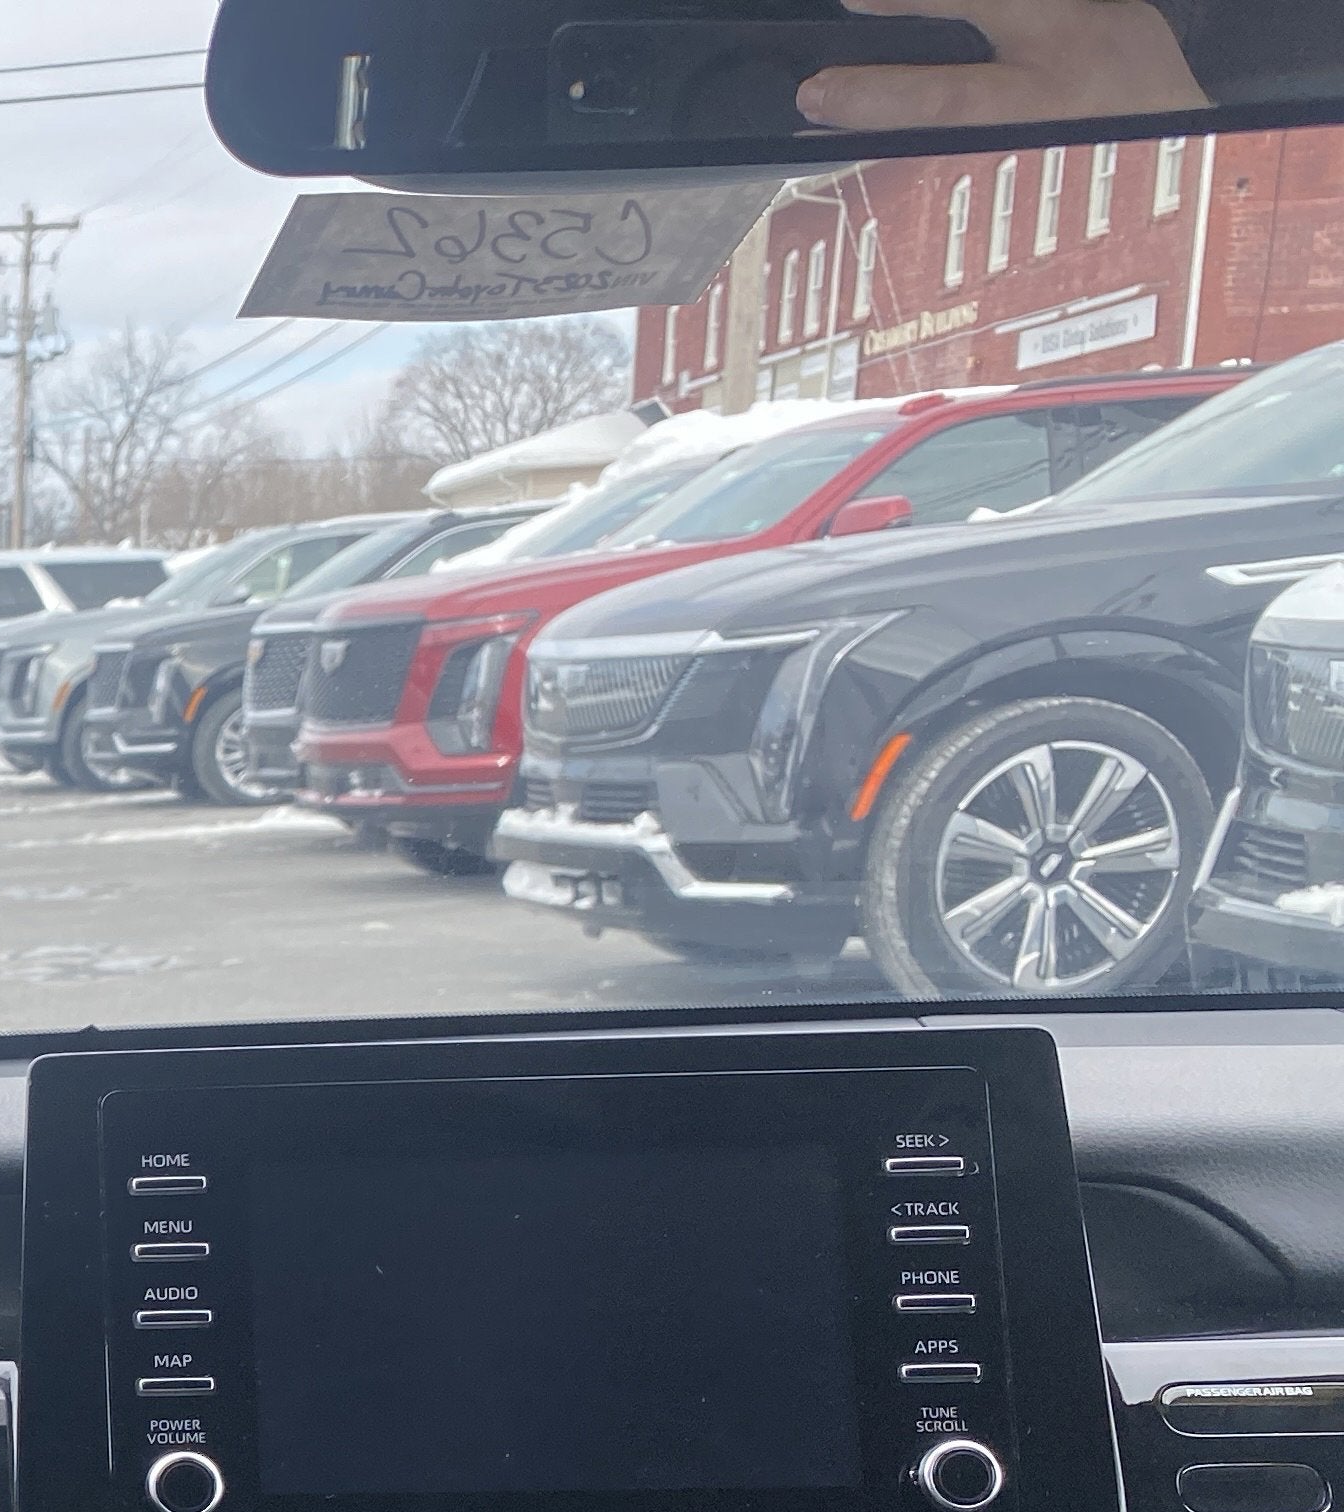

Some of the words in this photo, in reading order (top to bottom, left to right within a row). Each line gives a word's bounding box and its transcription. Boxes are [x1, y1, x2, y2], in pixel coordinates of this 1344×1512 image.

[896, 1135, 935, 1148] SEEK
[141, 1154, 190, 1168] HOME
[905, 1202, 960, 1216] TRACK
[144, 1220, 192, 1234] MENU
[901, 1271, 960, 1285] PHONE
[144, 1287, 198, 1301] AUDIO
[914, 1340, 959, 1354] APPS
[154, 1354, 192, 1368] MAP
[1186, 1387, 1262, 1397] PASSENGER
[1263, 1387, 1284, 1396] AIR
[1285, 1386, 1313, 1396] BAG
[920, 1407, 958, 1419] TUNE
[150, 1419, 201, 1431] POWER
[916, 1420, 968, 1432] SCROLL
[147, 1432, 206, 1444] VOLUME
